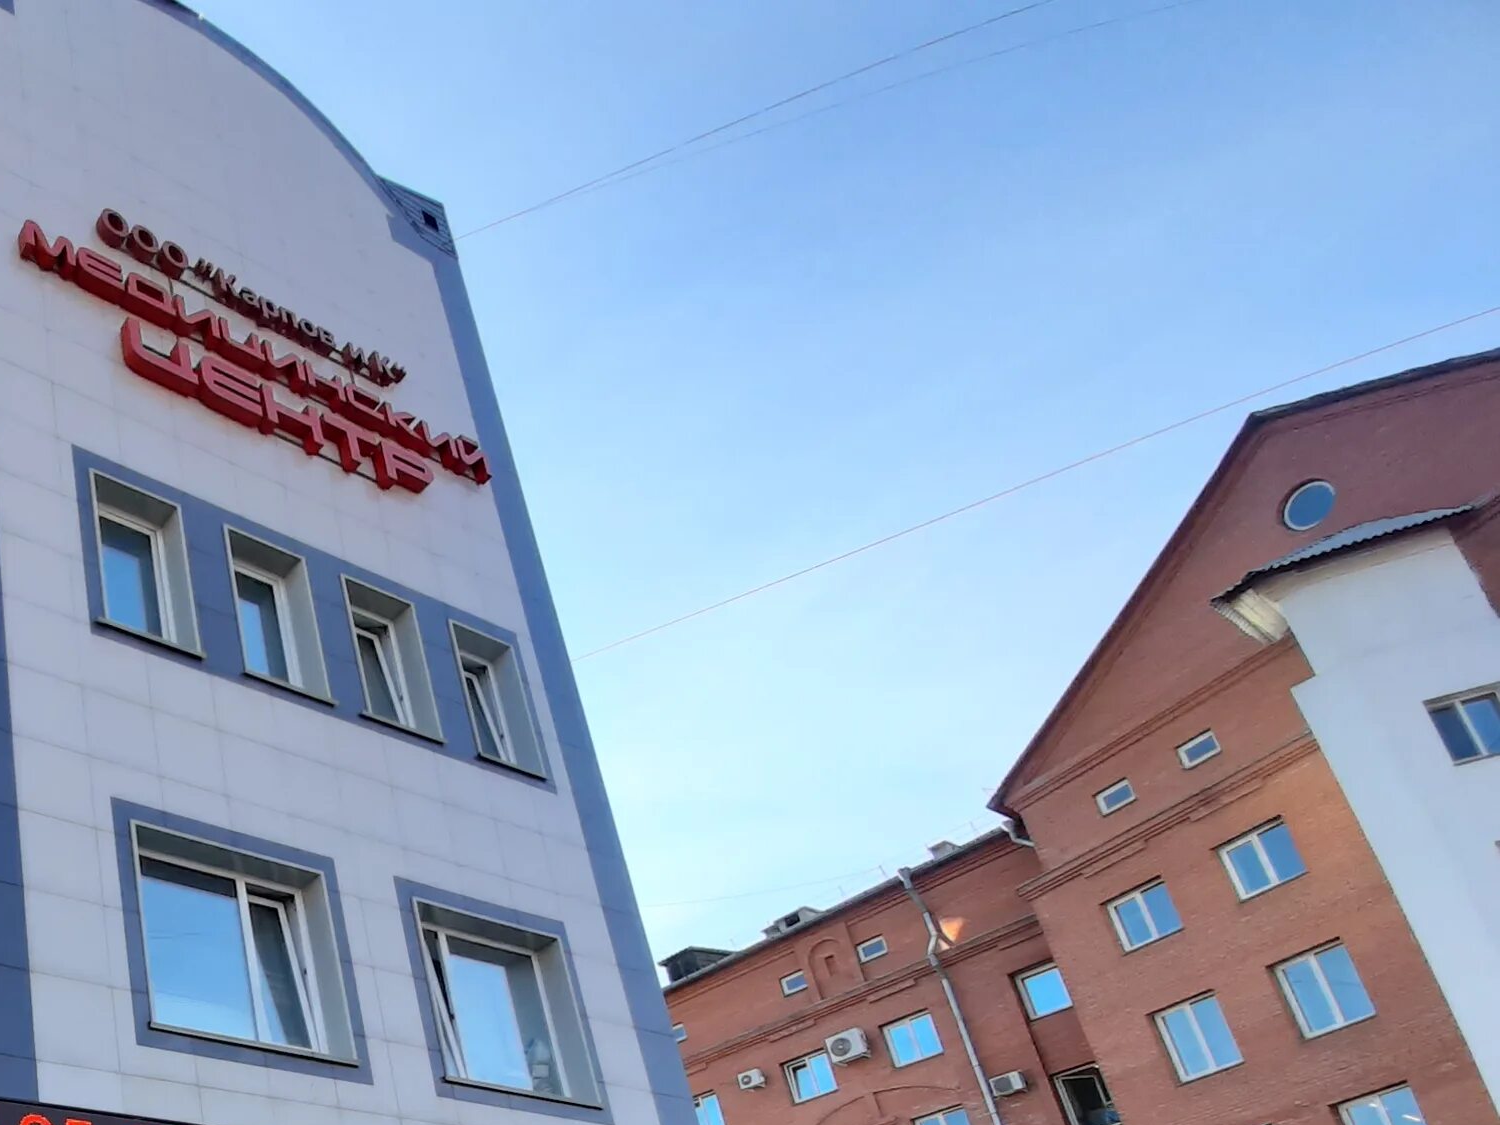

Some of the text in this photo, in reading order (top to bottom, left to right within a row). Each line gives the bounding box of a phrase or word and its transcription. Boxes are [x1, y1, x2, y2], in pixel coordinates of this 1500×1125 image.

[96, 208, 189, 280] ООО
[18, 219, 492, 486] МЕДИЦИНСКИЙ
[121, 316, 436, 494] ЦЕНТР
